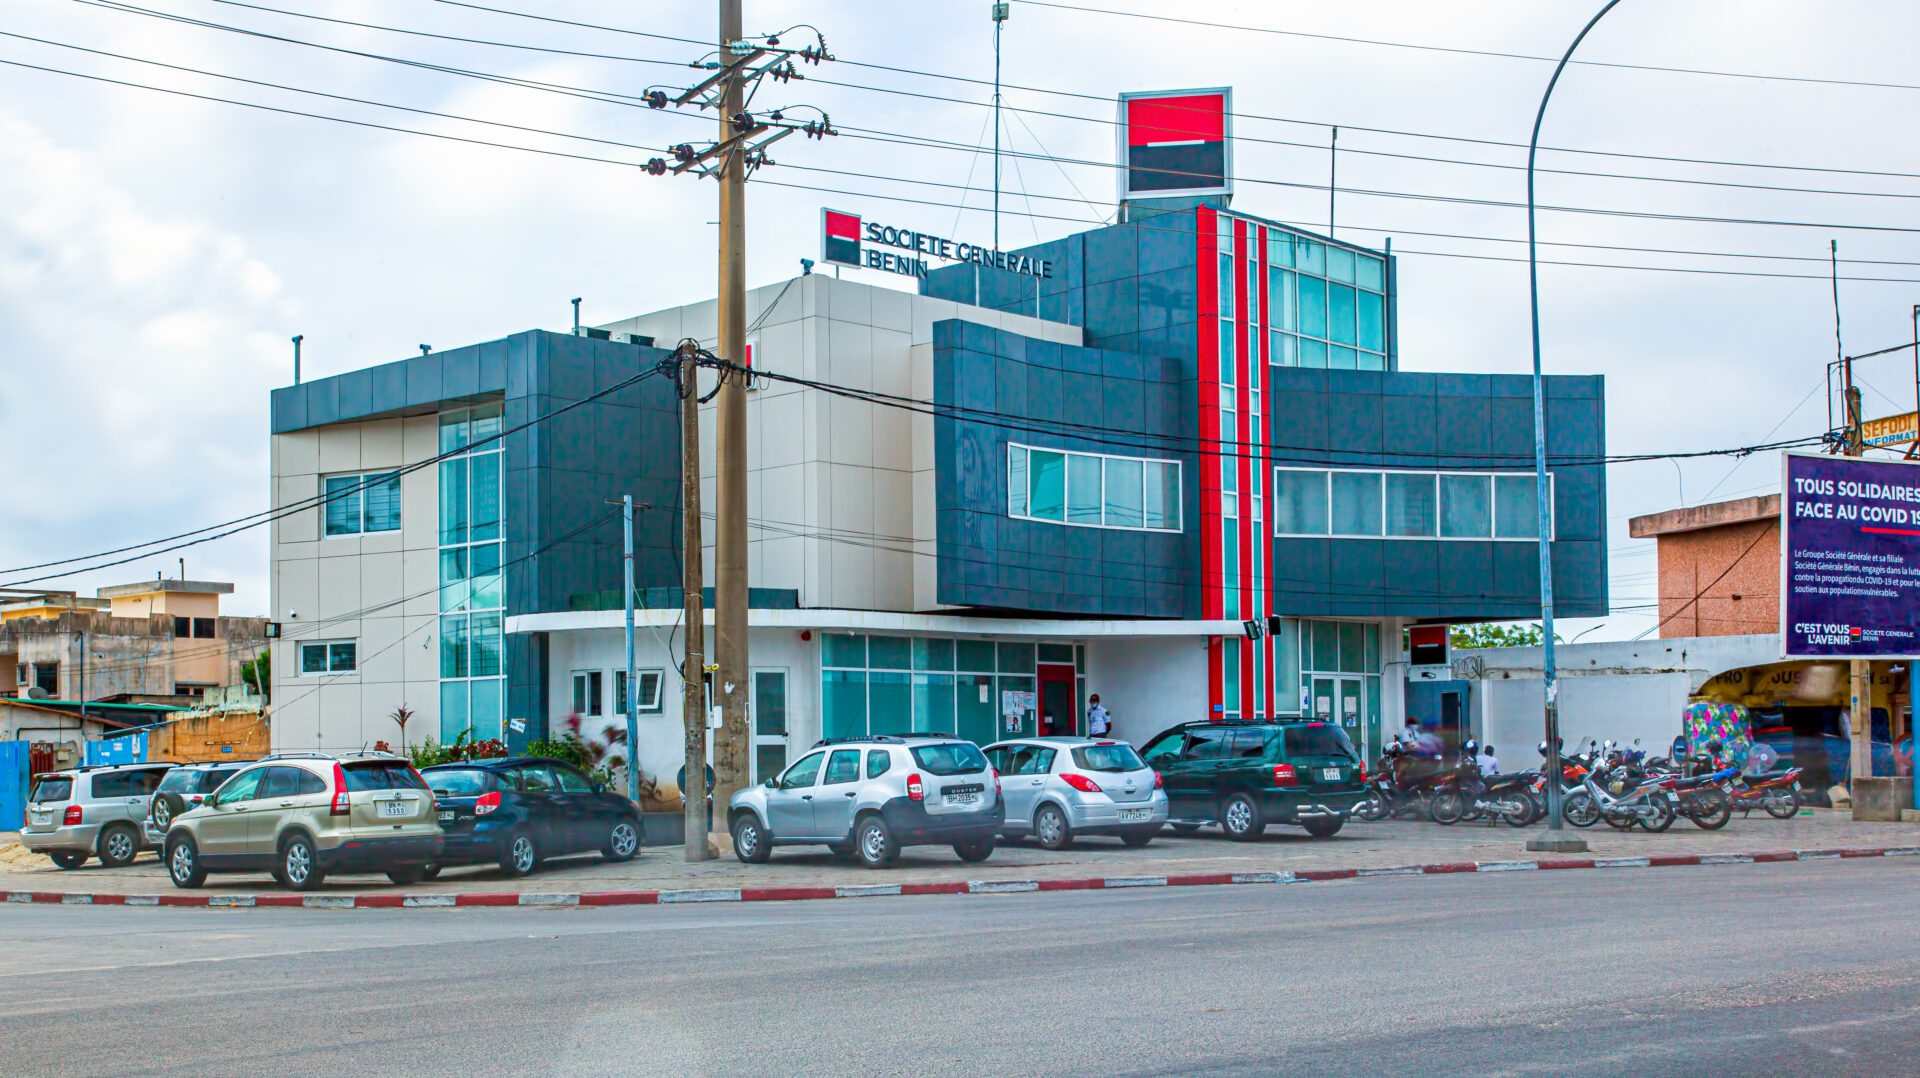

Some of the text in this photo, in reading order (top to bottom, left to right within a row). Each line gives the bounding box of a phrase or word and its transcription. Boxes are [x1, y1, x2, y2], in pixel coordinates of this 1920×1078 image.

[866, 222, 1052, 279] SOCIETE GENERALE
[866, 249, 928, 279] BENIN
[1795, 478, 1920, 503] TOUS SOLIDAIRES
[1795, 501, 1833, 519] FACE
[1836, 504, 1857, 520] AU
[1860, 506, 1908, 524] COVID
[1794, 549, 1904, 564] Le Groupe Société Générale et sa filiale
[1795, 560, 1817, 570] Société
[1817, 562, 1843, 571] Générale
[1844, 563, 1861, 573] Bénin,
[1862, 565, 1886, 576] engagés
[1886, 566, 1901, 574] dans
[1901, 566, 1908, 575] la
[1795, 574, 1815, 582] contre
[1815, 573, 1821, 582] la
[1865, 576, 1892, 586] COVID-19
[1899, 579, 1914, 588] pour
[1795, 585, 1817, 593] soutien
[1795, 622, 1850, 635] C'EST VOUS
[1862, 629, 1914, 638] SOCIETE GENERALE
[1808, 634, 1850, 645] L'AVENIR
